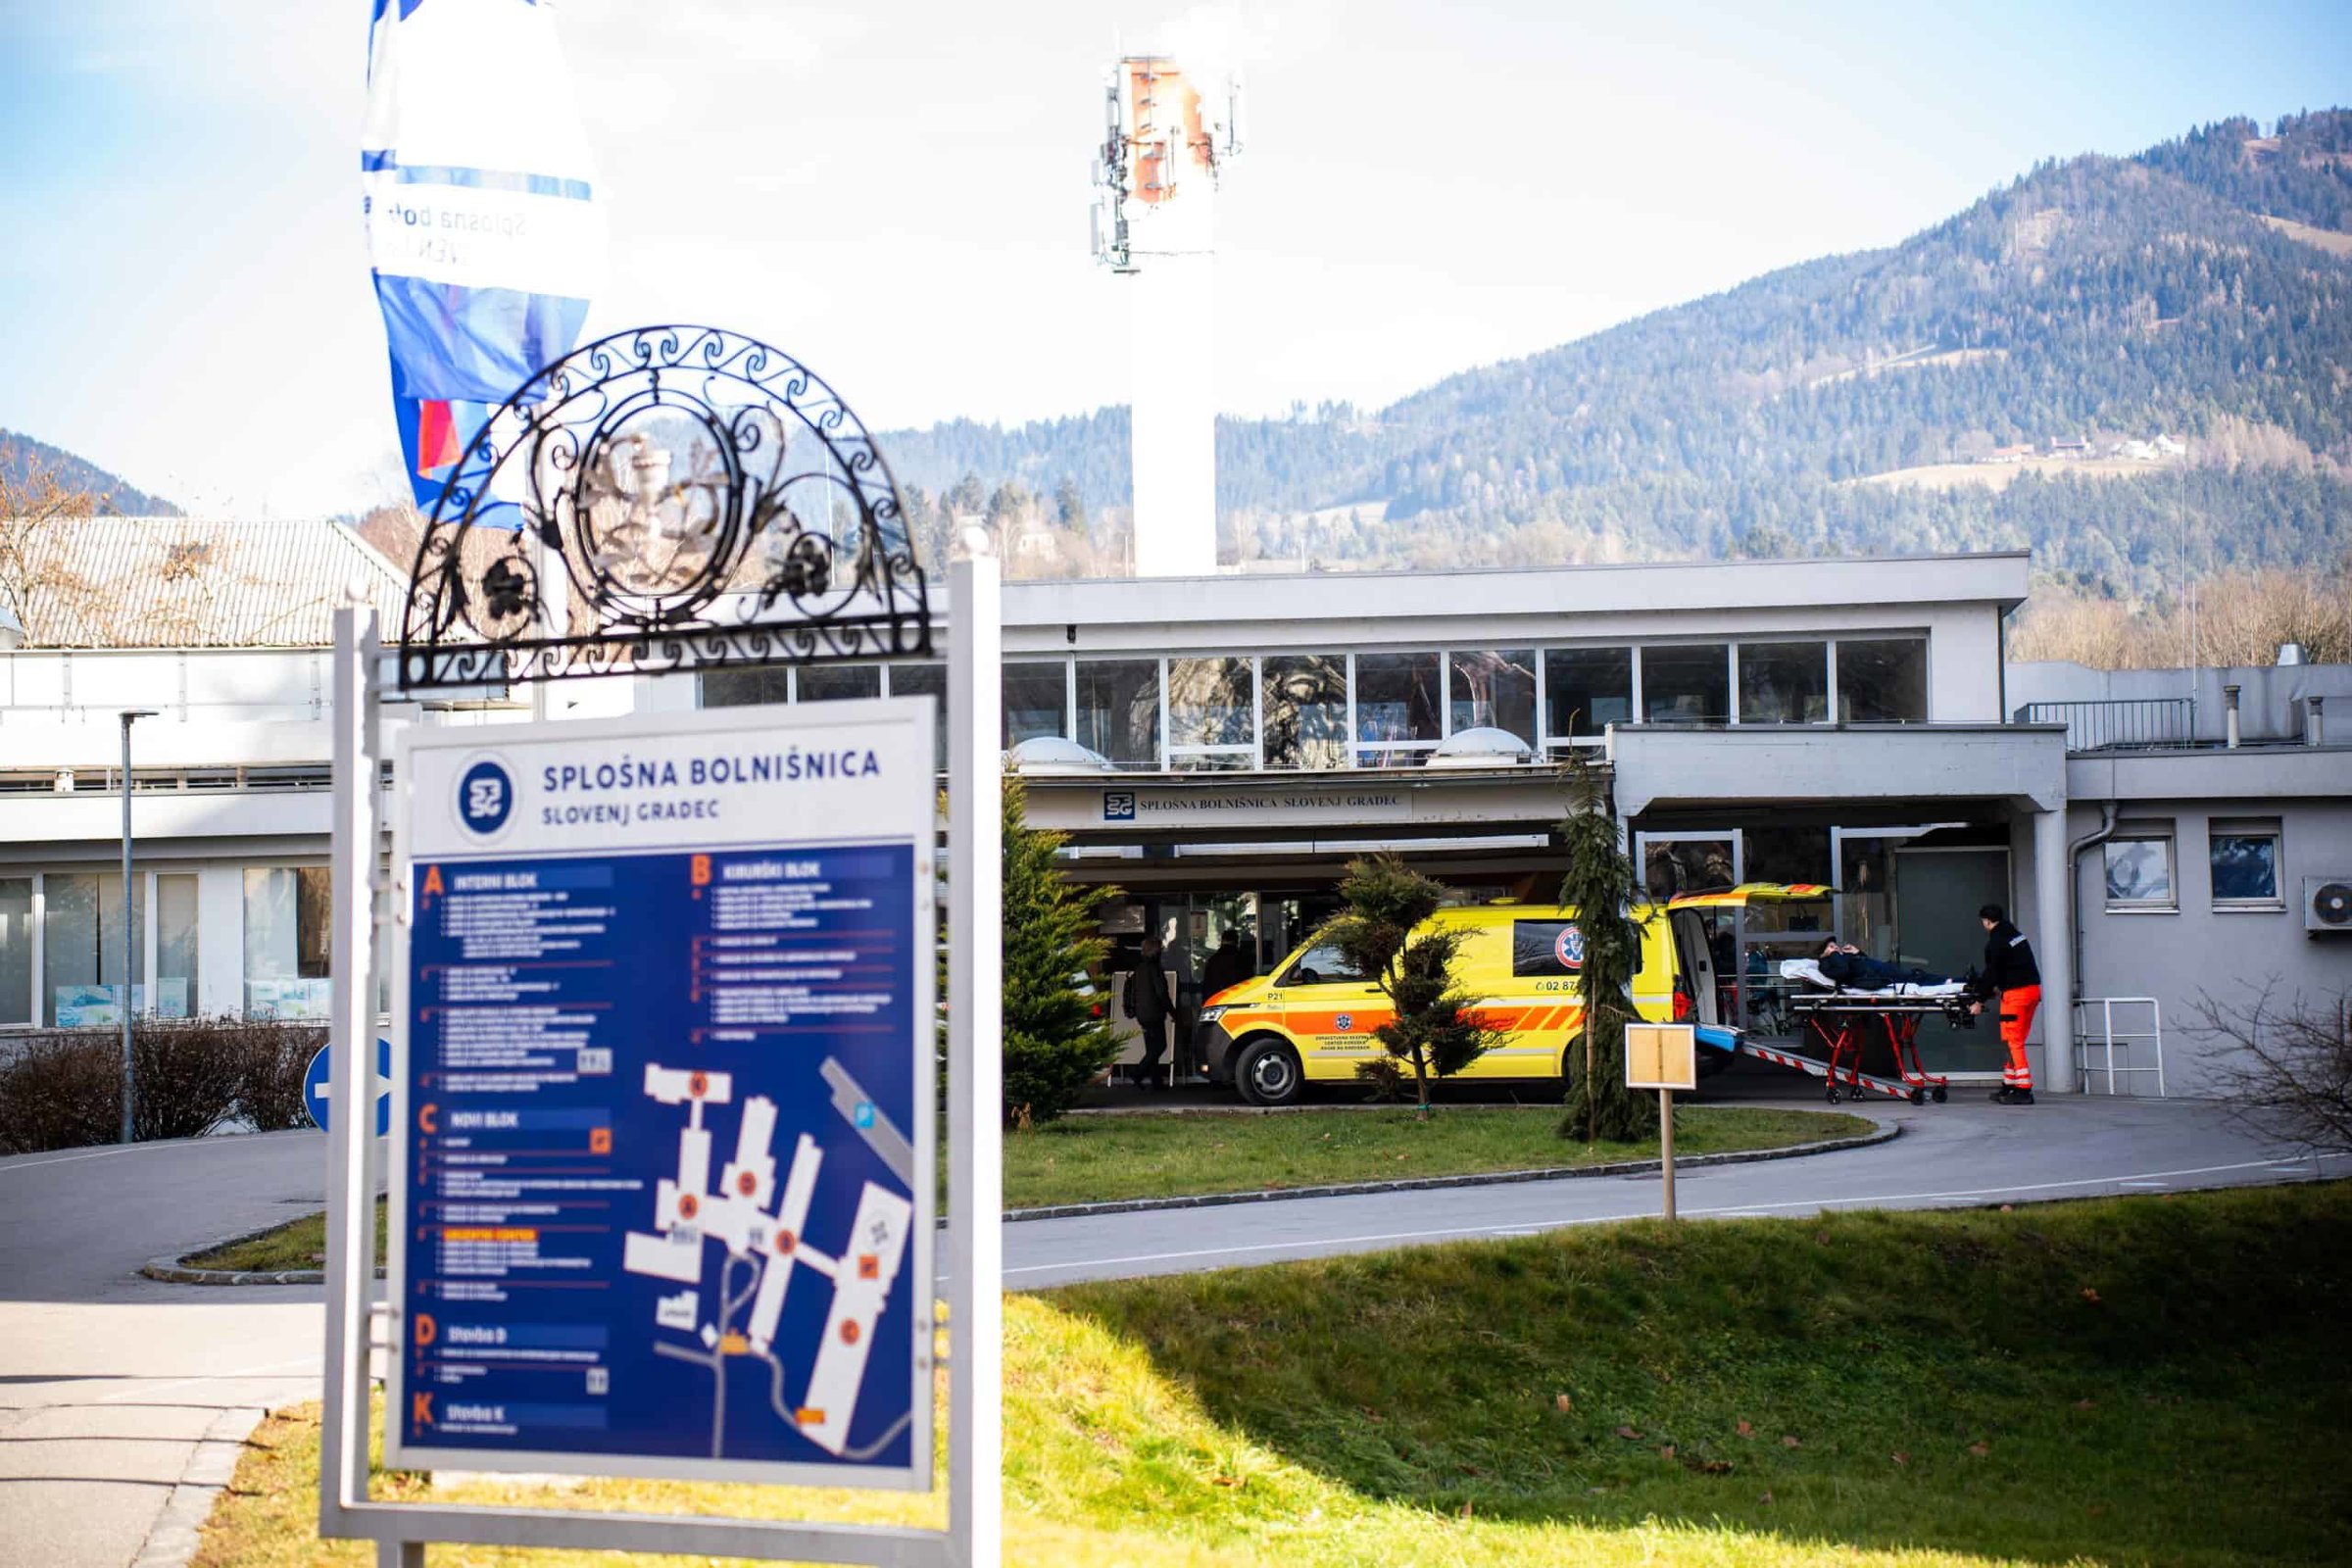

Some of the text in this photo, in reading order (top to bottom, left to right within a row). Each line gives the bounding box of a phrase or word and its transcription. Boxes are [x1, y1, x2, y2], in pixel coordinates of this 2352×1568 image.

[543, 744, 880, 791] SPLOŠNA BOLNIŠNICA
[543, 799, 720, 827] SLOVENJ GRADEC
[1348, 794, 1401, 808] GRADEC
[422, 865, 444, 895] A
[691, 855, 711, 885] B
[1546, 981, 1559, 991] 02
[418, 1103, 437, 1134] C
[415, 1313, 436, 1346] D
[414, 1392, 434, 1424] K
